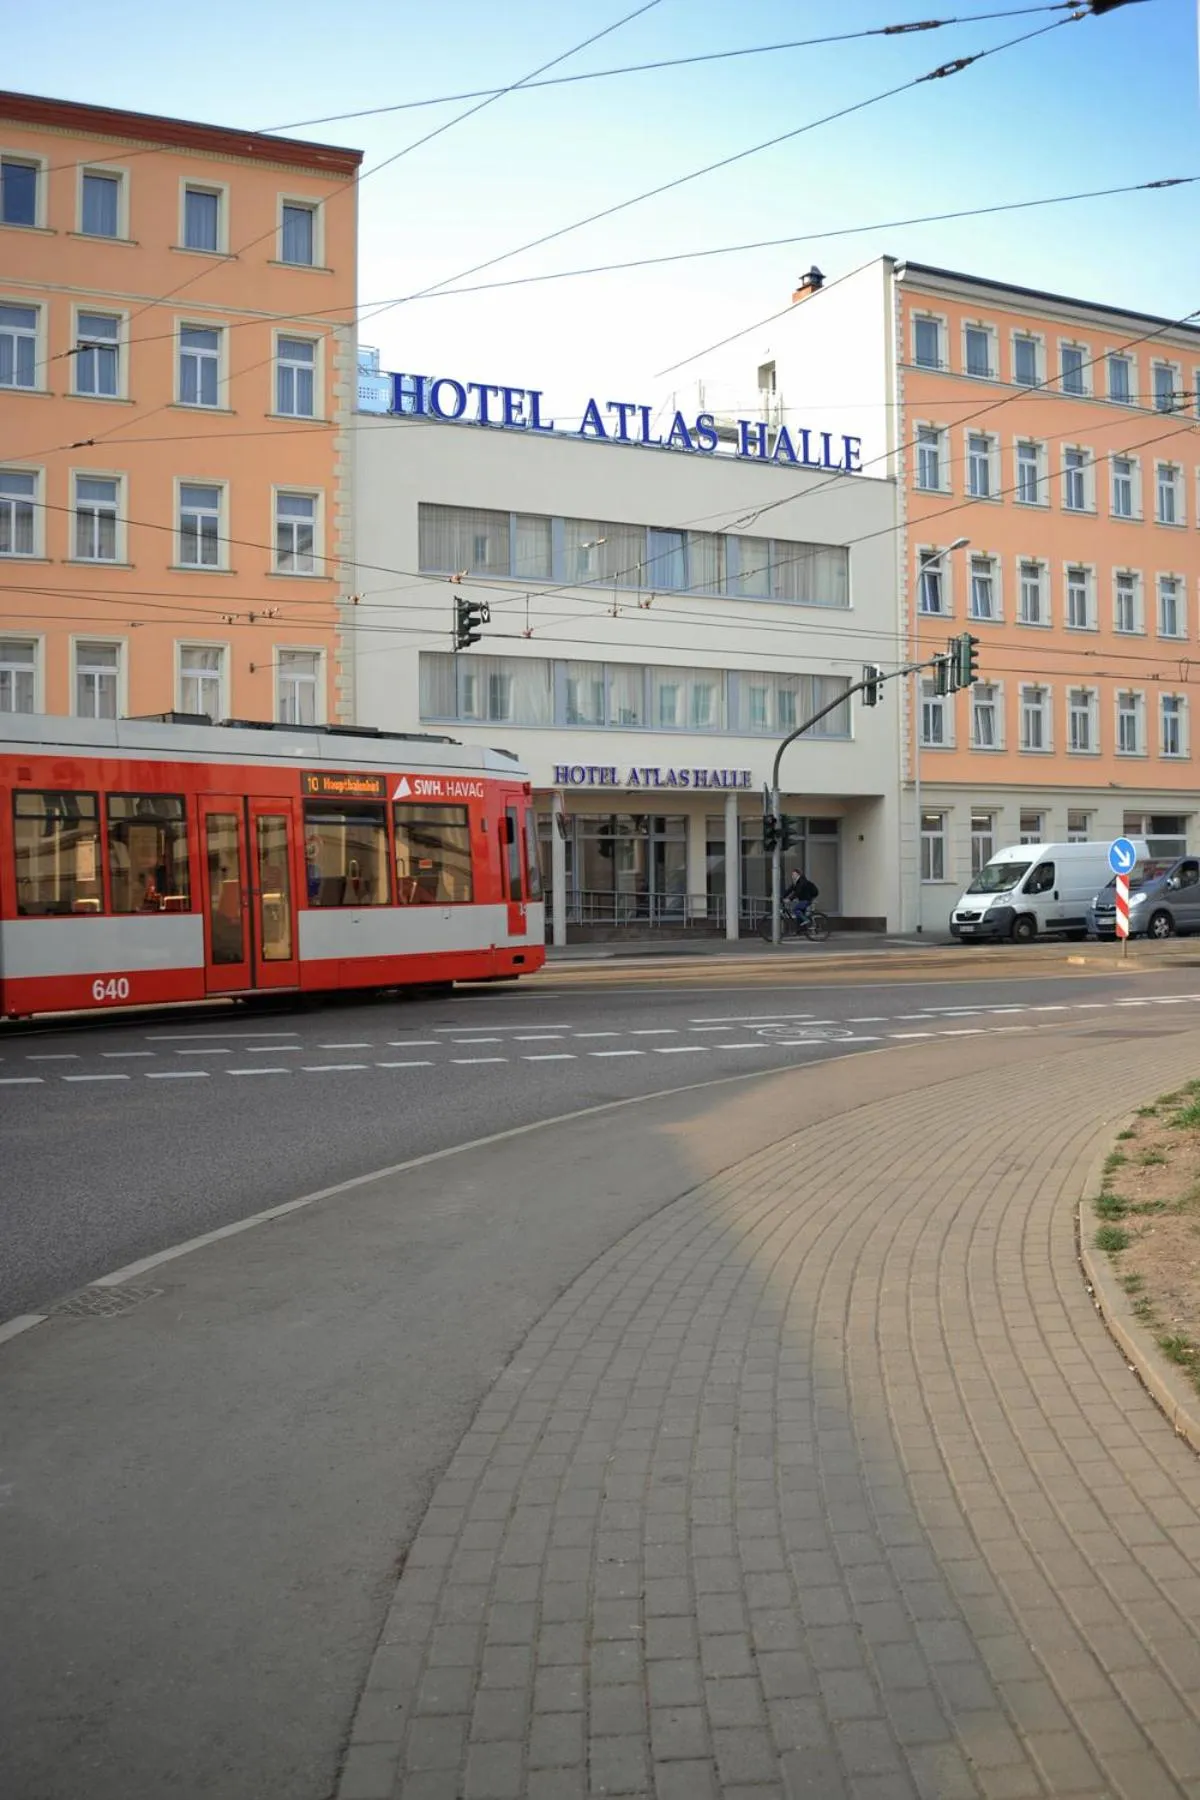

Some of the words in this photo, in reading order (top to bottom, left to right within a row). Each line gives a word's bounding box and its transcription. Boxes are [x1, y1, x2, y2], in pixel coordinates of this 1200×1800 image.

[388, 372, 554, 431] HOTEL
[577, 398, 719, 451] ATLAS
[737, 419, 864, 472] HALLE
[554, 765, 620, 785] HOTEL
[626, 767, 690, 787] ATLAS
[692, 769, 752, 788] HALLE
[414, 779, 444, 796] SWH.
[446, 780, 485, 798] HAVAG
[92, 977, 129, 1000] 640
